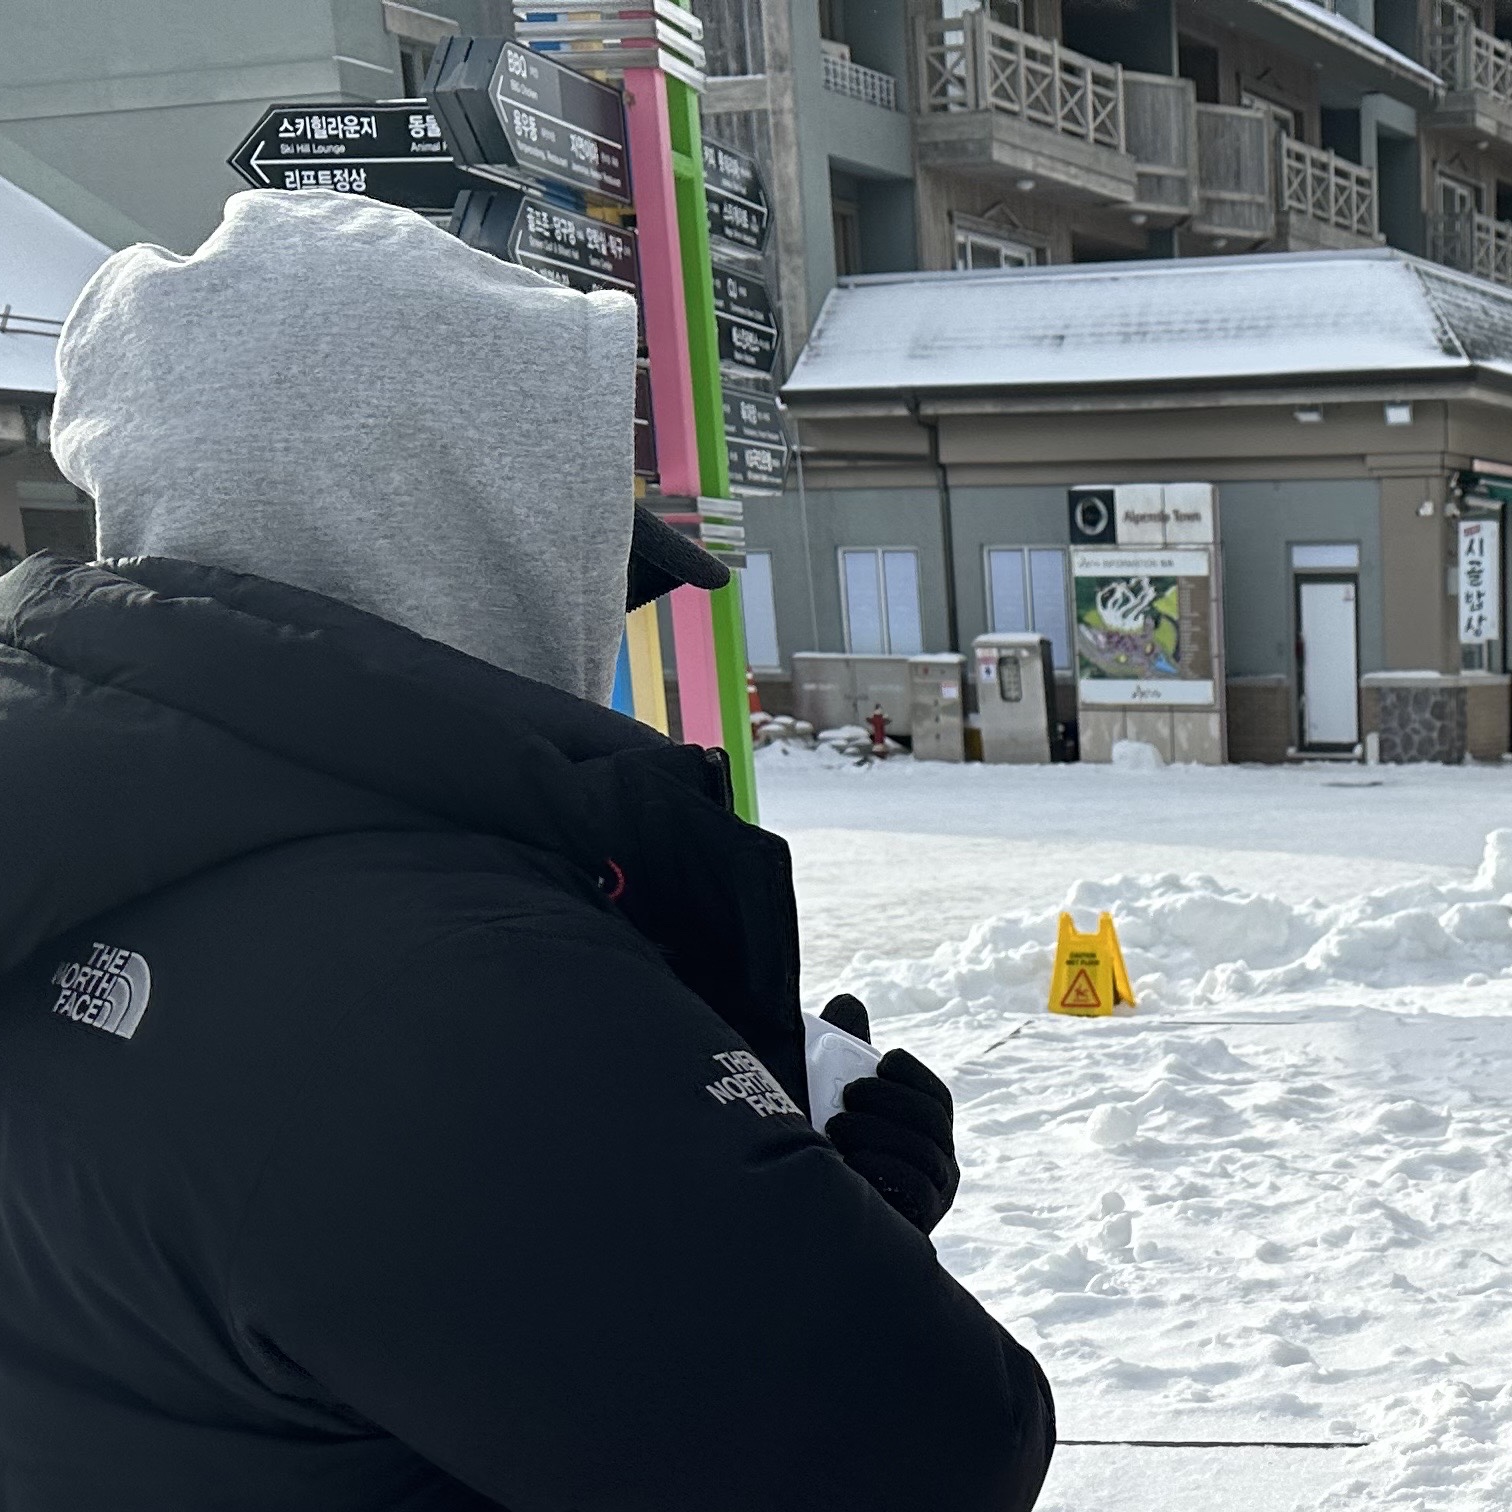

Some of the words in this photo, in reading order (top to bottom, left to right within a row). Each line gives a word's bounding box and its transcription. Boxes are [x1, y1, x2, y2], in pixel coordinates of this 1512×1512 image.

[278, 115, 378, 140] 스키힐라운지
[280, 143, 295, 154] Ski
[313, 143, 346, 154] Lounge
[410, 141, 441, 152] Animal
[284, 168, 367, 192] 리프트정상
[87, 942, 131, 974] THE
[51, 961, 118, 999] NORTH
[52, 989, 104, 1024] FACE
[712, 1050, 761, 1073] THE
[705, 1072, 775, 1105] NORTH
[746, 1093, 795, 1118] FACE
